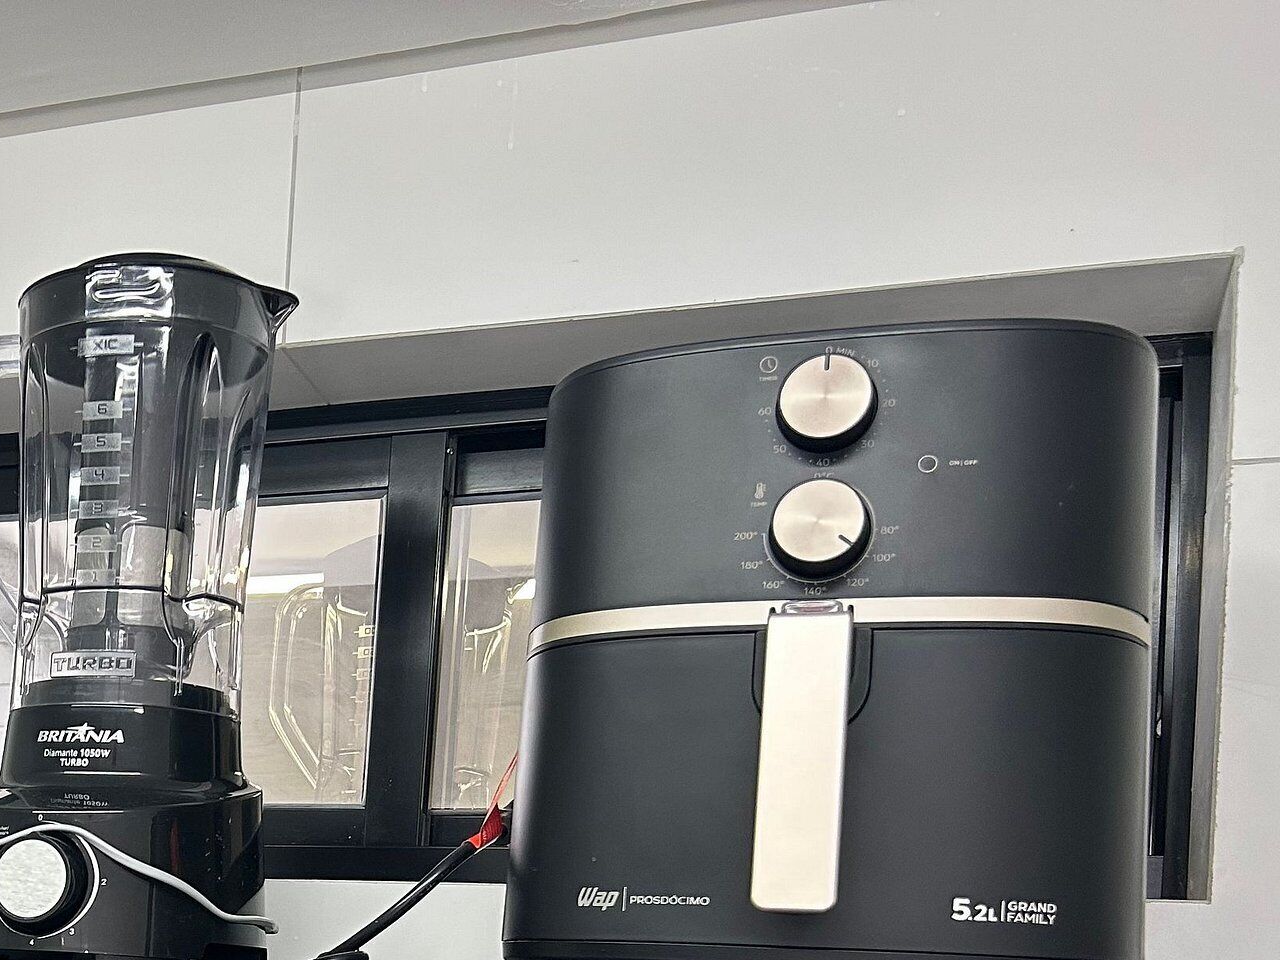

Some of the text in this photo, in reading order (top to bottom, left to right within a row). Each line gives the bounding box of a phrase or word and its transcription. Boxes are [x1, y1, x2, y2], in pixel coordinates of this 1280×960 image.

[836, 347, 856, 357] MIN
[98, 403, 107, 415] 6
[758, 407, 772, 415] 60
[97, 436, 106, 447] 5
[861, 440, 874, 448] 30
[774, 445, 786, 453] 50
[94, 469, 104, 480] 4
[92, 537, 101, 548] 2
[54, 656, 133, 672] TURBO
[44, 749, 111, 758] Diamante 1050W
[60, 758, 89, 767] TURBO
[577, 887, 710, 911] Wap PROSDÓCIMO
[1007, 901, 1057, 913] GRAND
[1007, 912, 1056, 925] FAMILY
